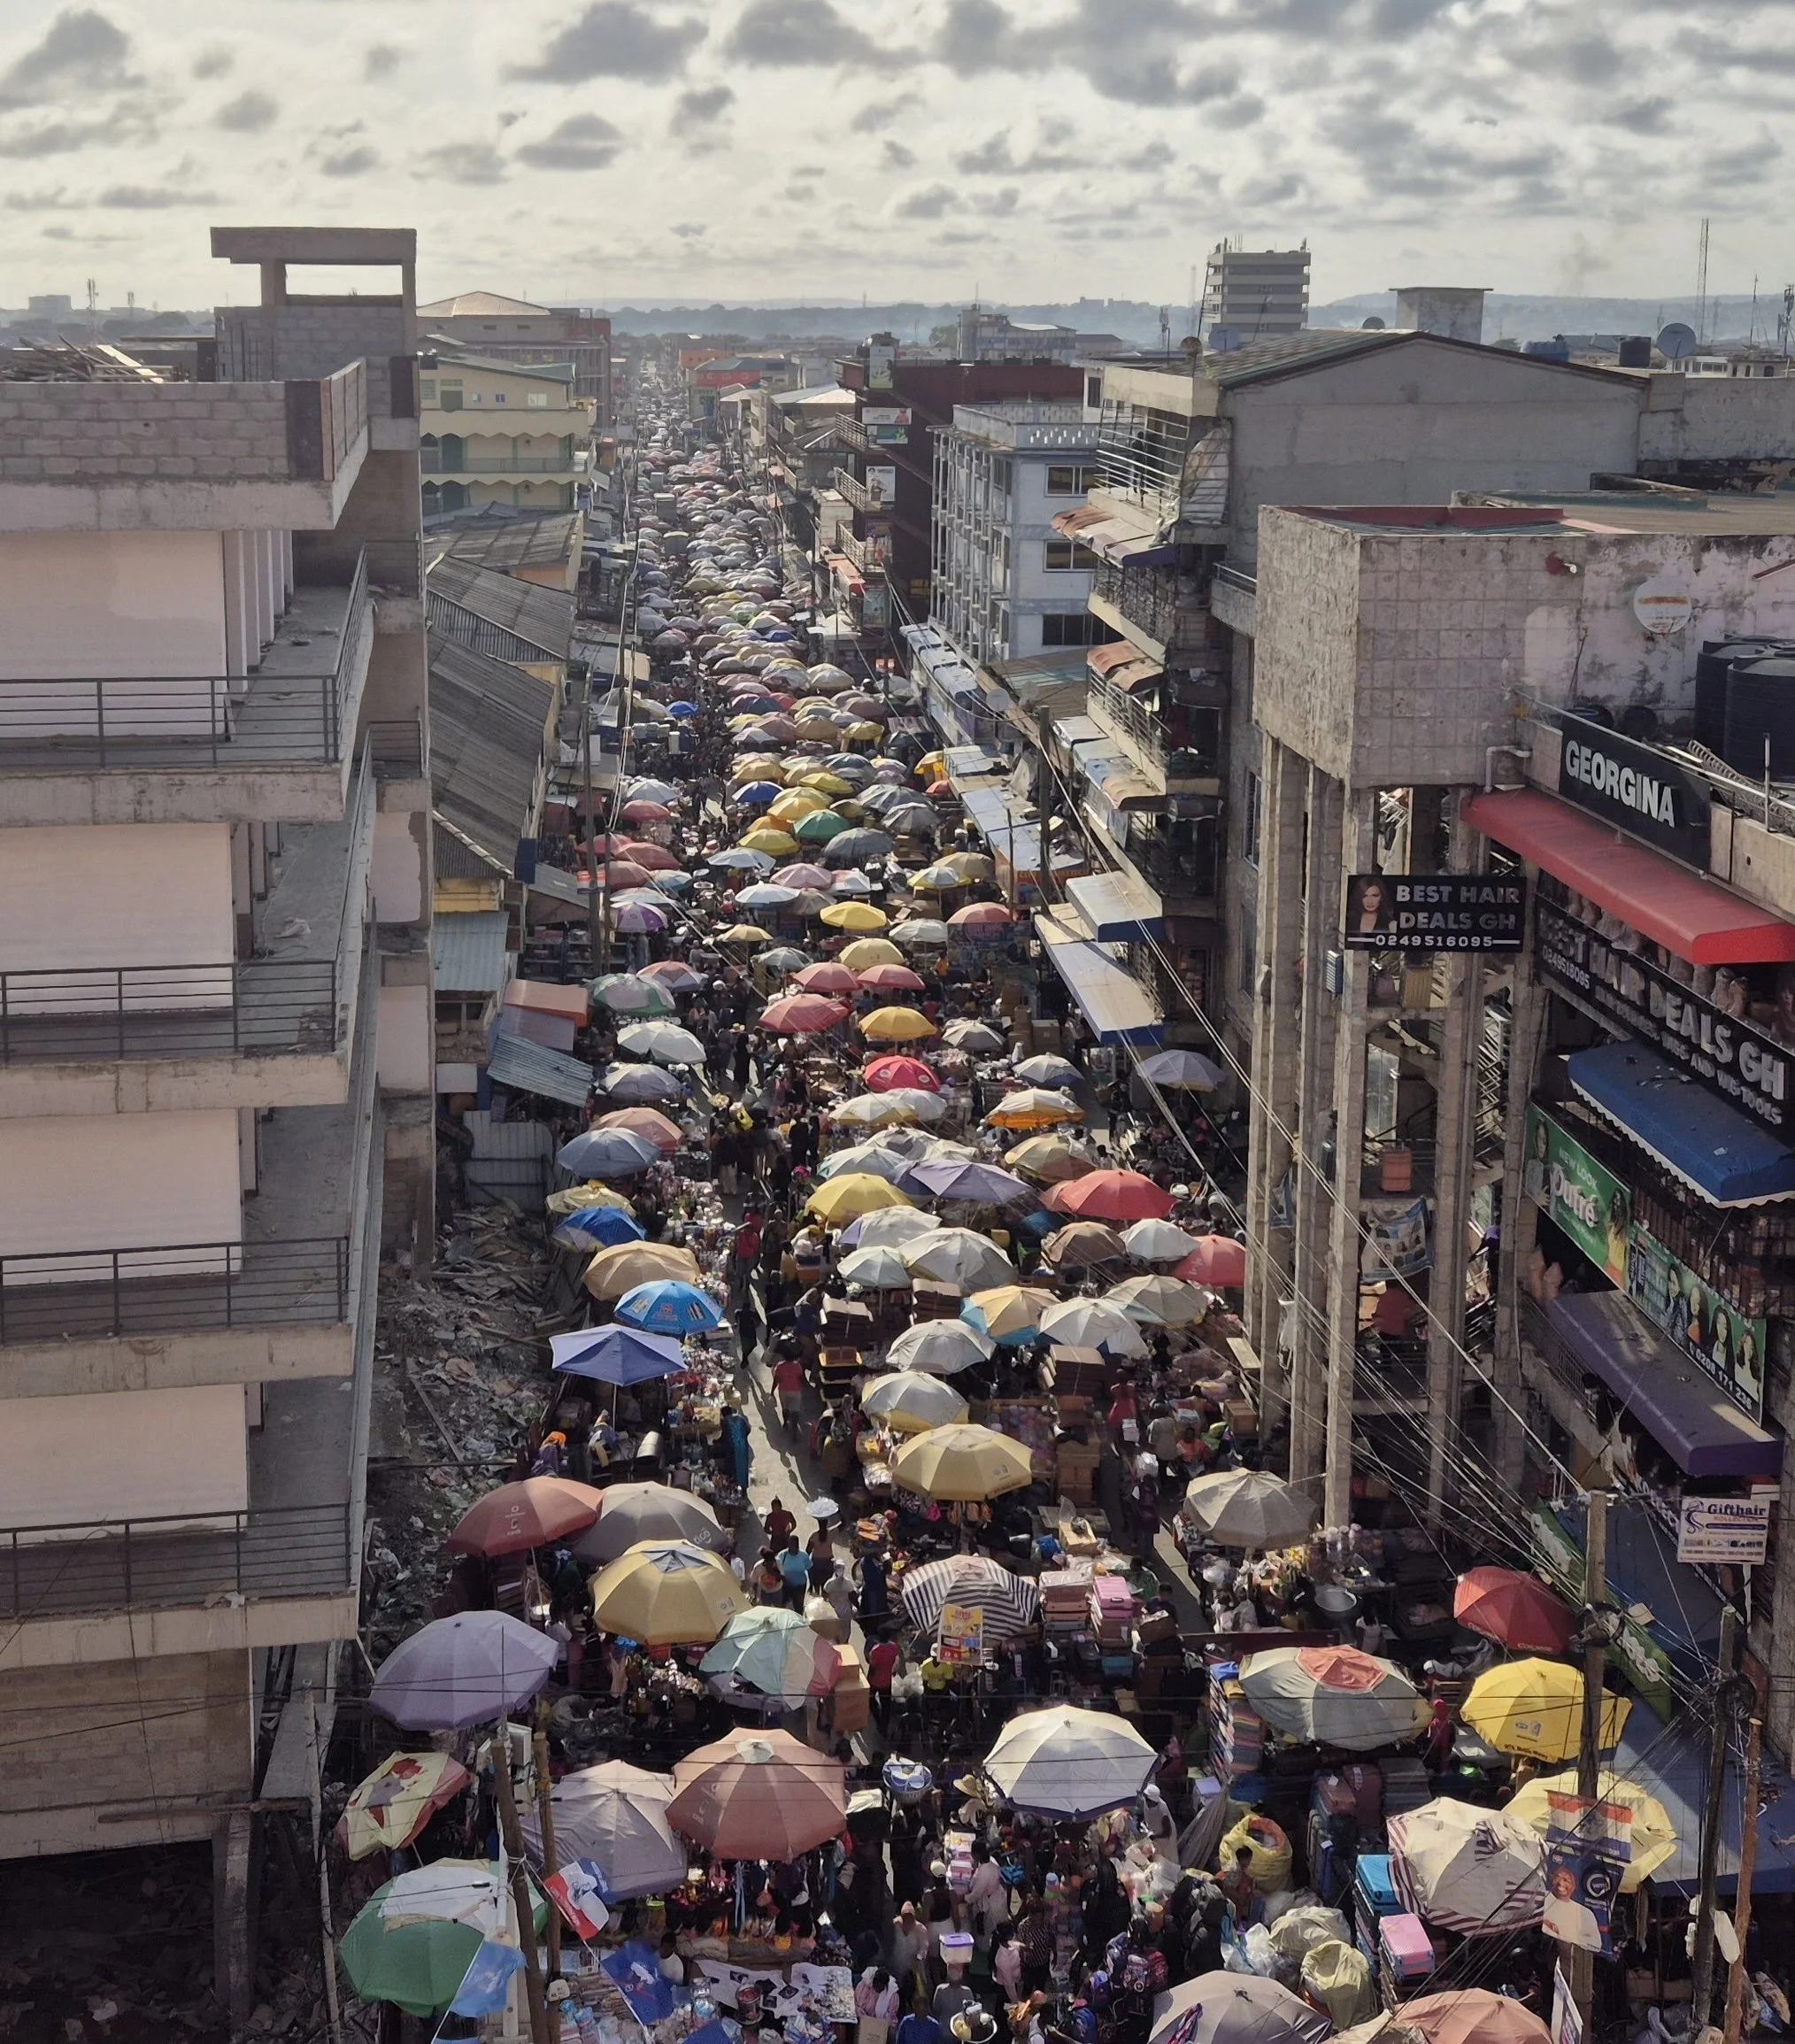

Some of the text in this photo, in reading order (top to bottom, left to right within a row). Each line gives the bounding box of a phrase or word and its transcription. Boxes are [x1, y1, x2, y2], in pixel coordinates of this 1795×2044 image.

[1566, 740, 1675, 828] GEORGINA
[1396, 885, 1520, 904] BEST HAIR
[1399, 912, 1516, 929] DEALS GH
[1375, 935, 1492, 947] 0249516095
[1590, 940, 1645, 1007] HAIR
[1649, 980, 1734, 1063] DEALS
[1738, 1041, 1784, 1100] GH
[1691, 1053, 1715, 1078] AND
[1740, 1085, 1782, 1125] TOOLS
[1576, 1163, 1599, 1192] LOOK
[1718, 1370, 1733, 1392] 171
[1707, 1503, 1766, 1516] Gifthair
